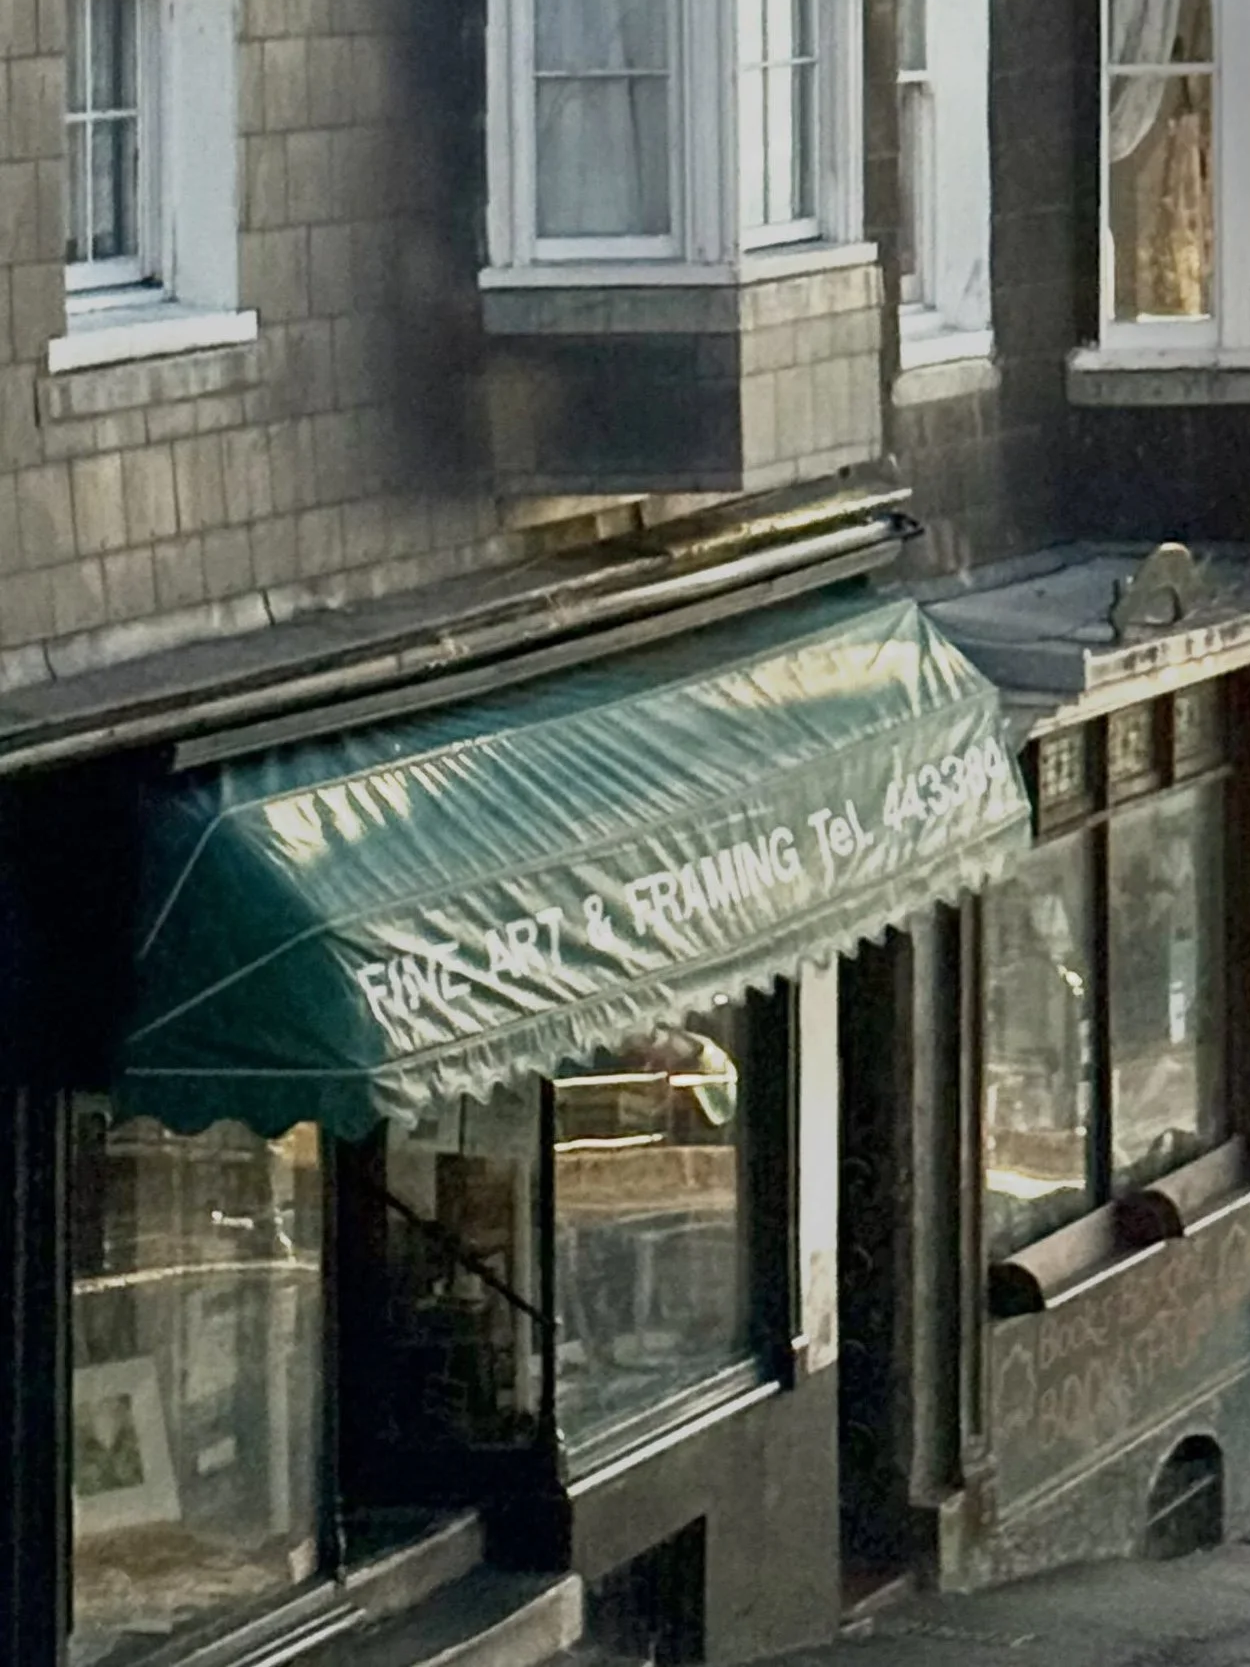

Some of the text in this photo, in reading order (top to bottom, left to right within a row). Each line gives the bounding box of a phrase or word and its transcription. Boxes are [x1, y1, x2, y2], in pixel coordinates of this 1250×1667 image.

[357, 941, 471, 1024] FINE
[485, 906, 563, 980] ART
[625, 826, 800, 936] FRAMING
